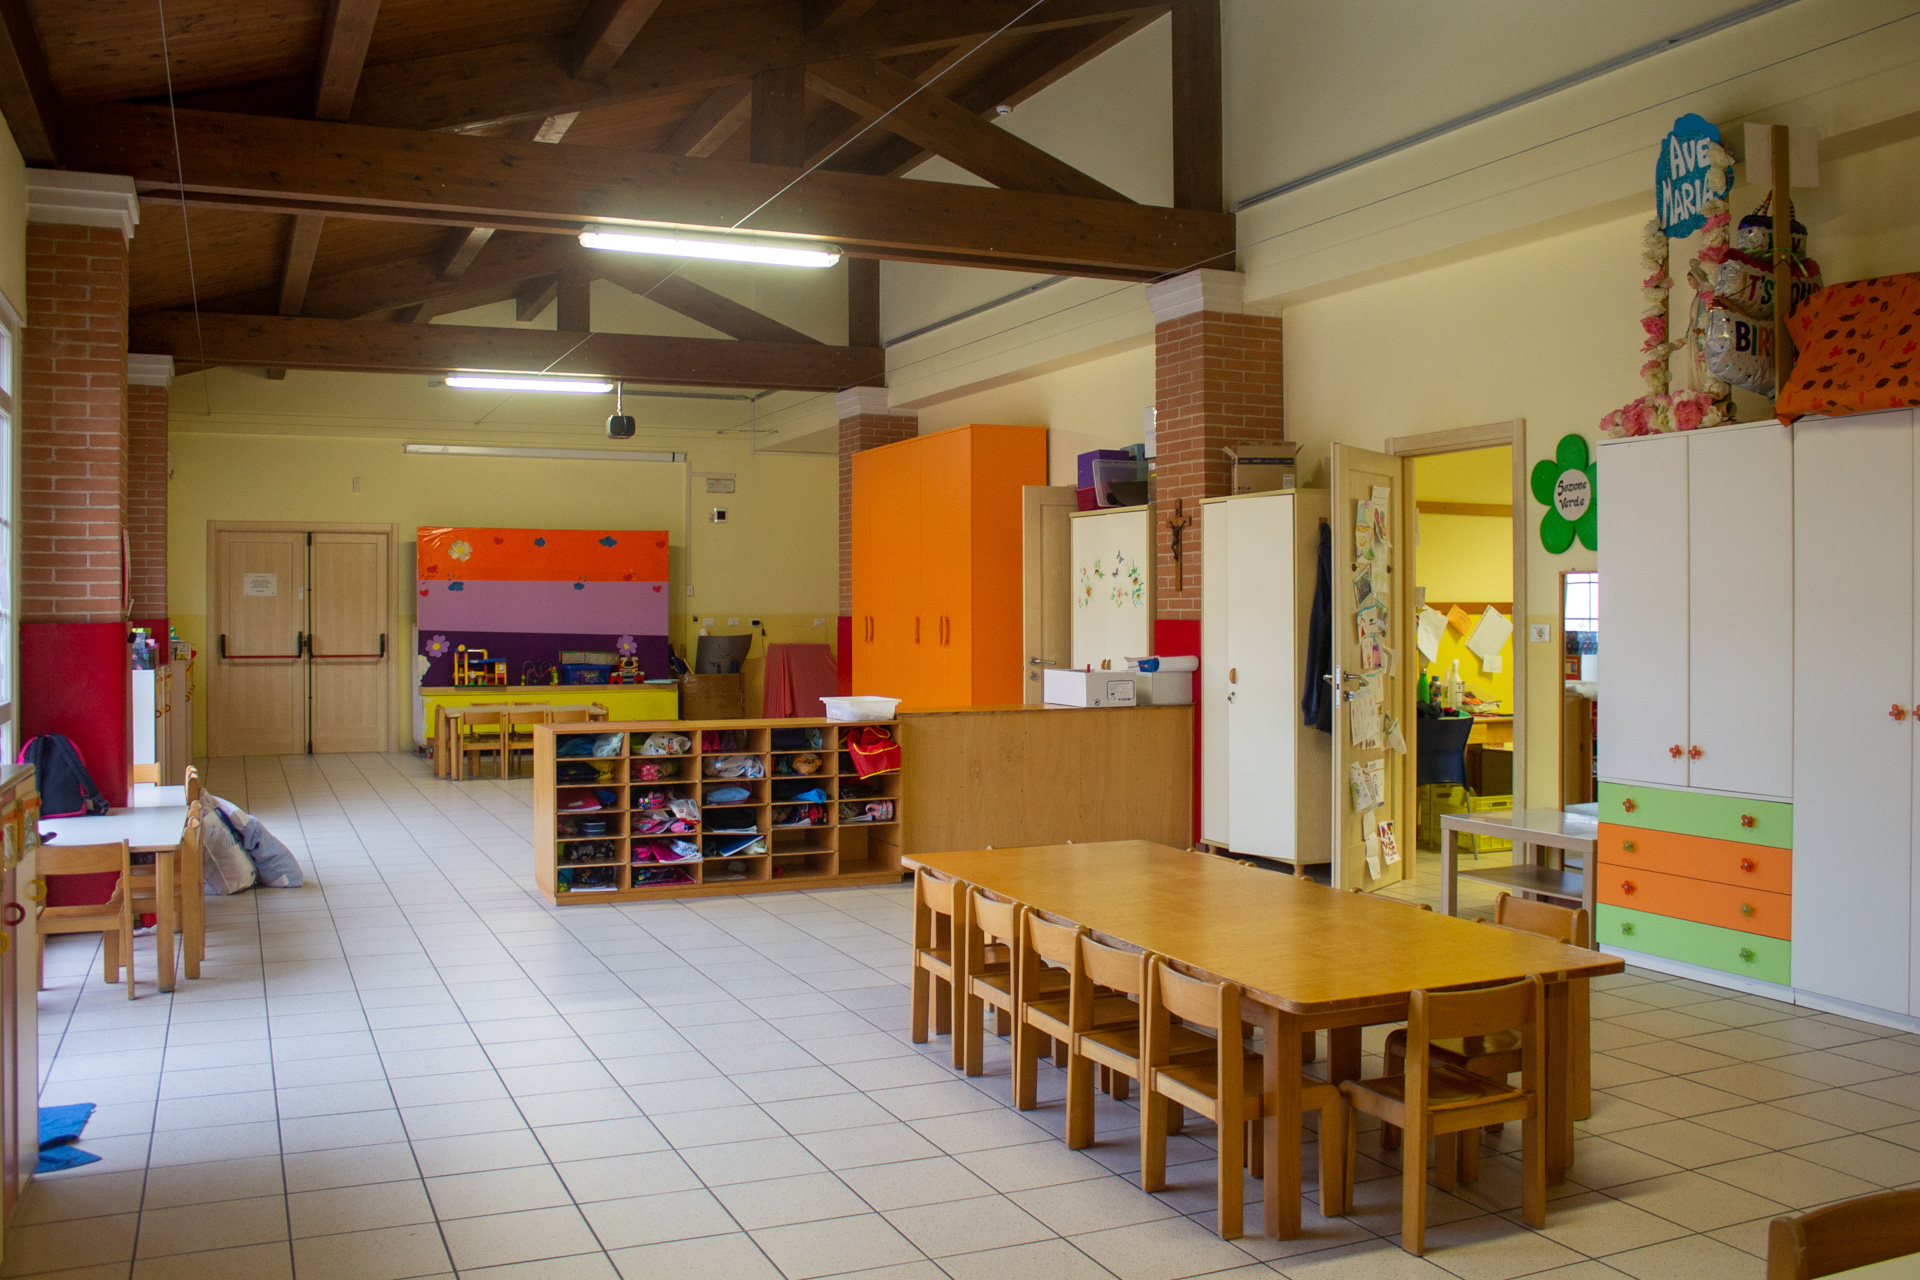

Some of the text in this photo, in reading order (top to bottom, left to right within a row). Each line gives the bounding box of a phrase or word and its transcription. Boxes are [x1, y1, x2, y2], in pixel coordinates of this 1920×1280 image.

[1670, 135, 1711, 180] AVE
[1739, 272, 1775, 304] IT'S
[1559, 496, 1585, 510] Verde
